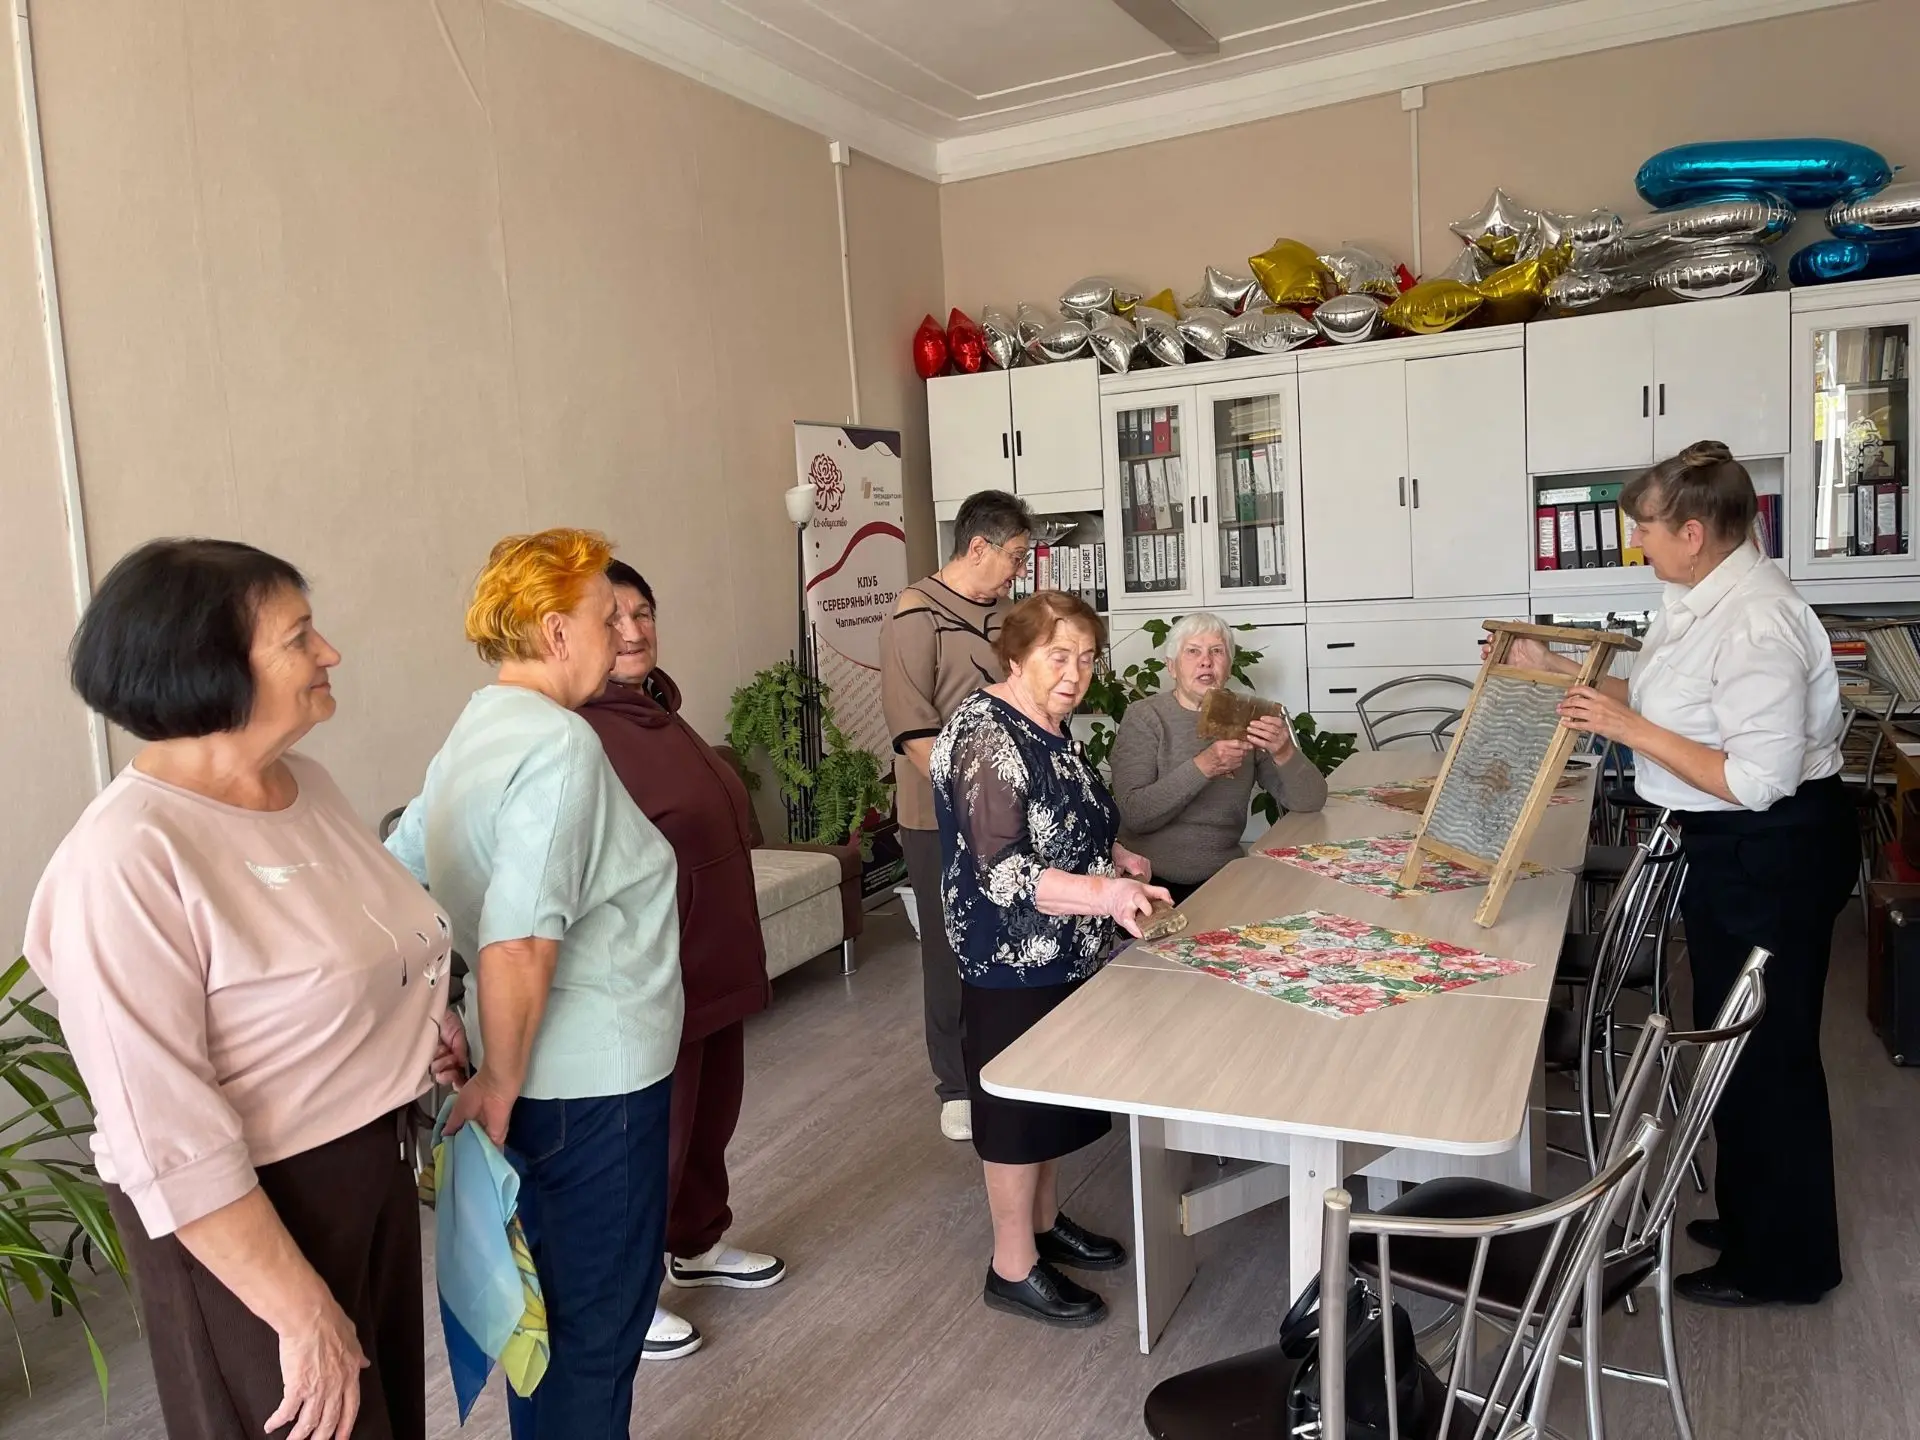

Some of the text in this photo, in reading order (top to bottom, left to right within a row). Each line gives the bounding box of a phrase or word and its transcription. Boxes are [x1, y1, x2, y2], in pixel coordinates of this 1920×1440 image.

[1083, 549, 1091, 582] ПЕДСОВЕТ
[857, 576, 878, 588] КЛУБ
[836, 612, 883, 628] Чаплыгинский
